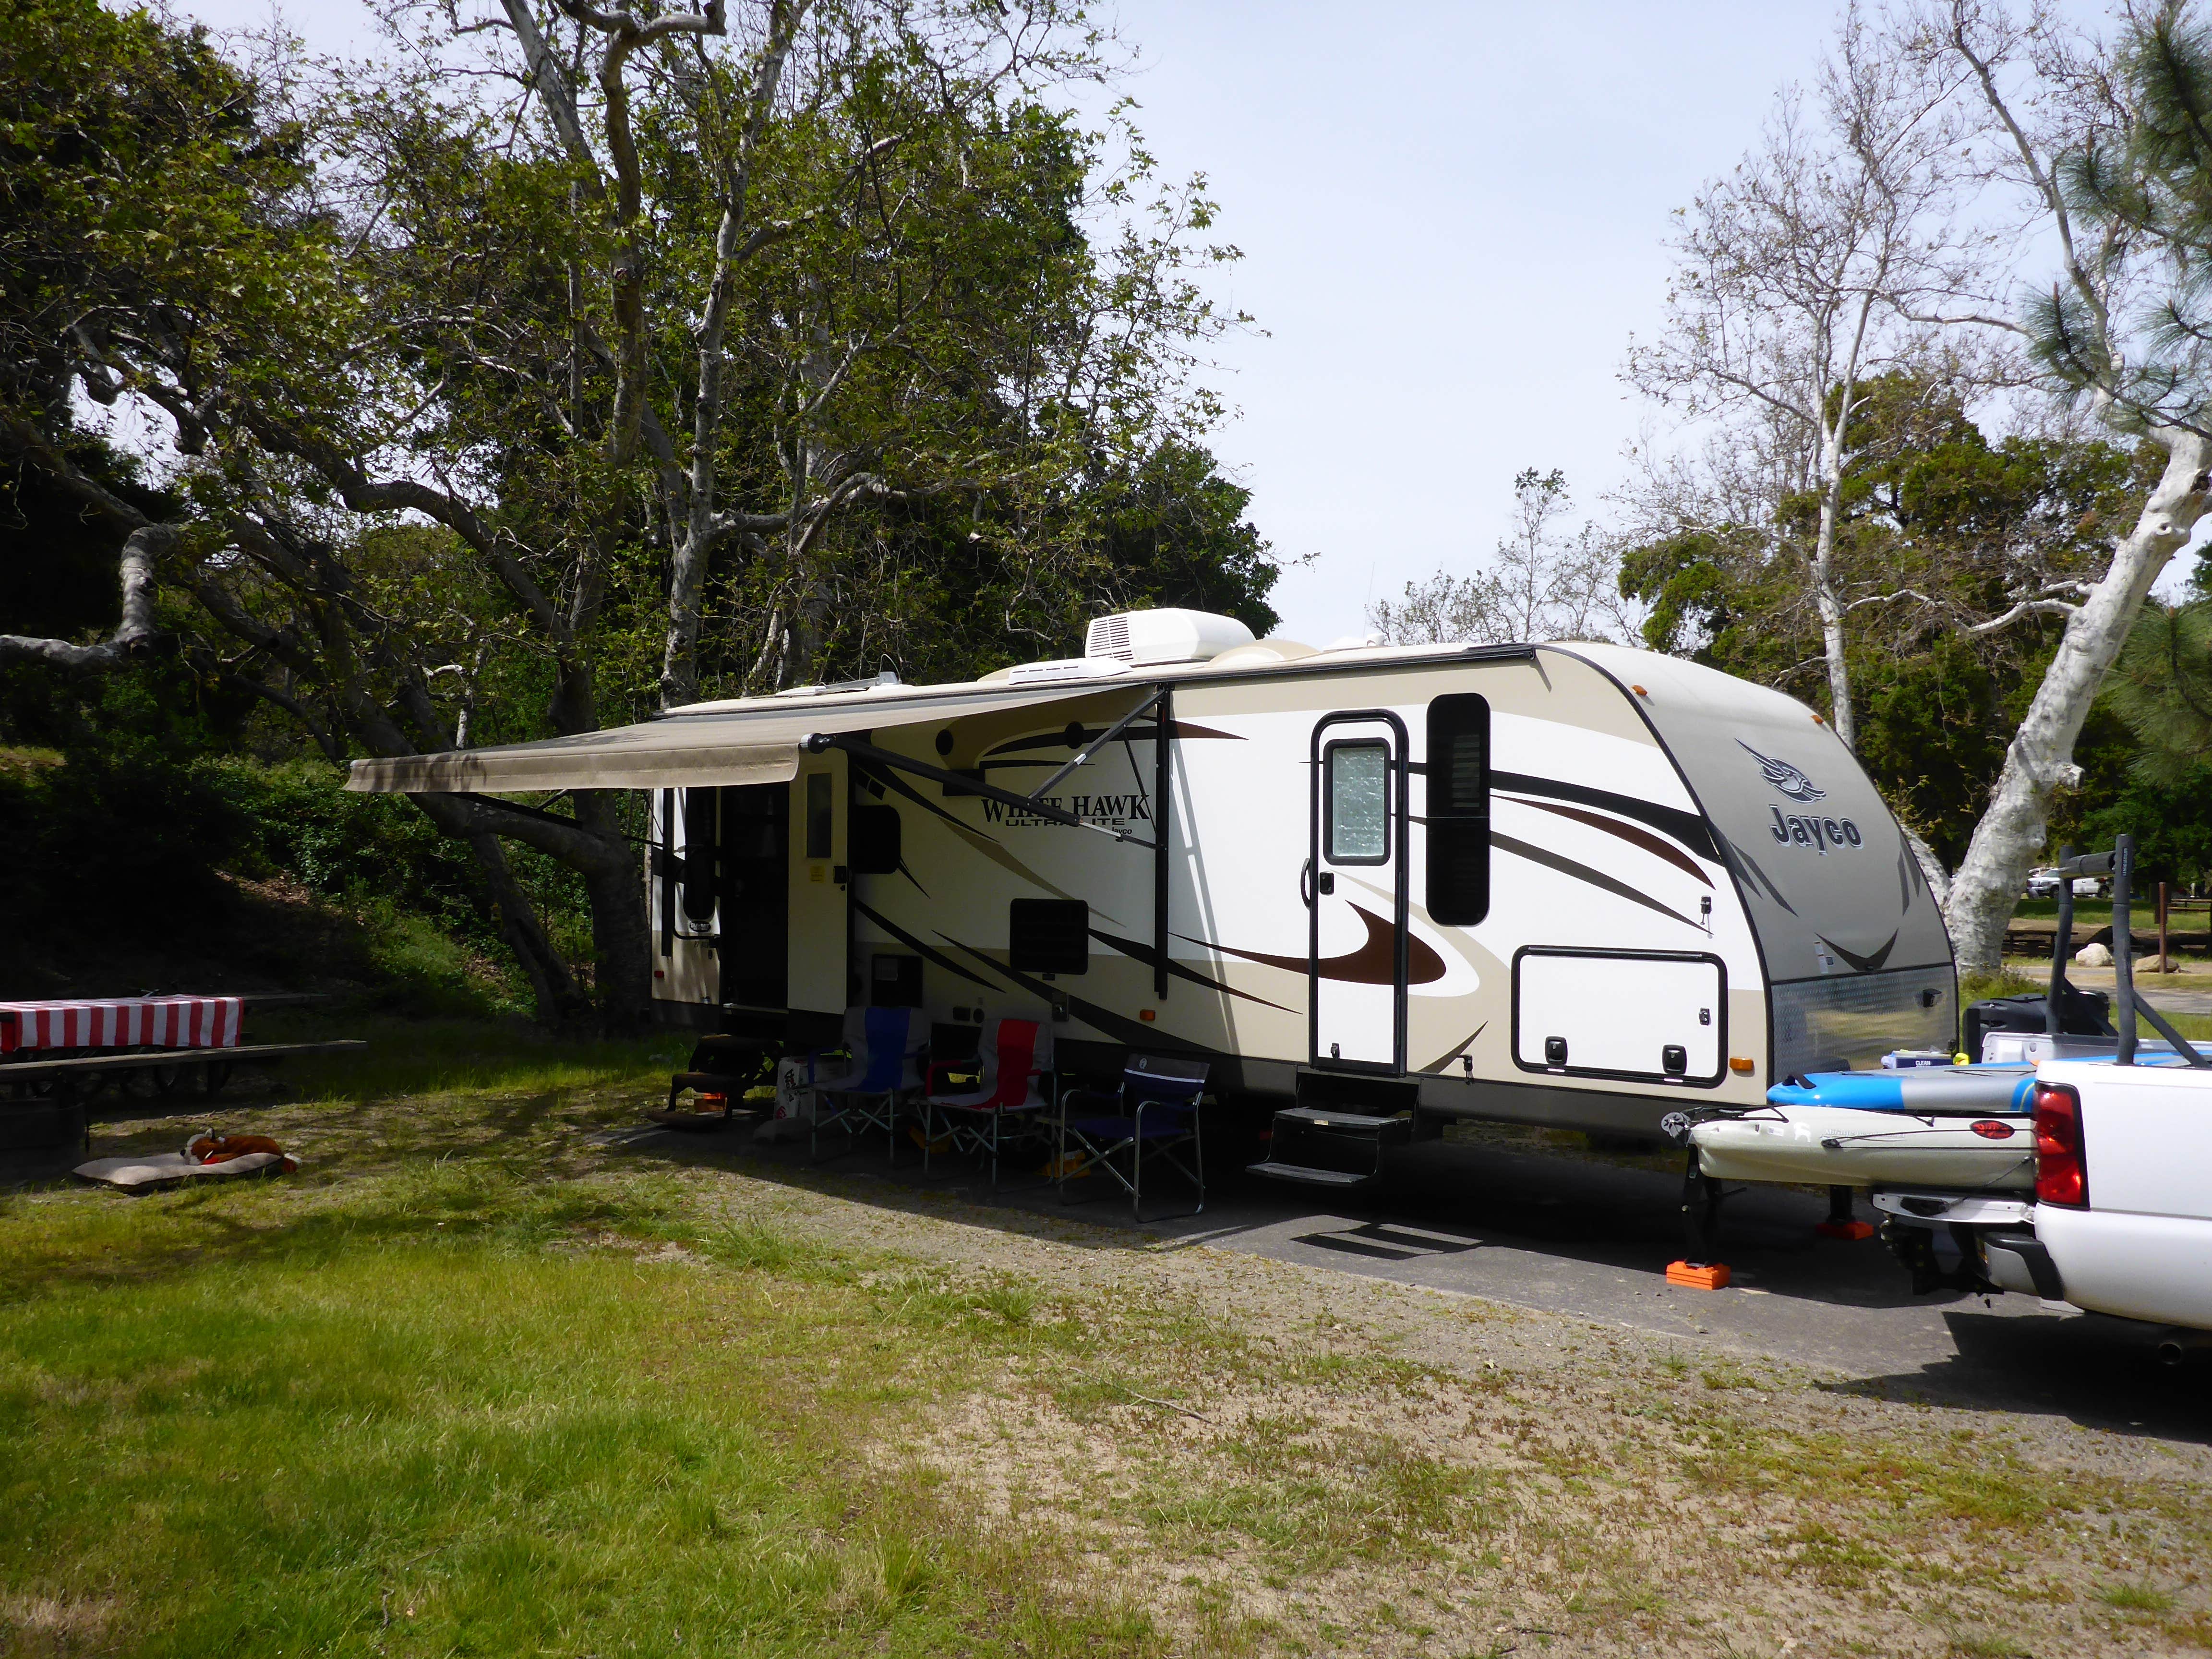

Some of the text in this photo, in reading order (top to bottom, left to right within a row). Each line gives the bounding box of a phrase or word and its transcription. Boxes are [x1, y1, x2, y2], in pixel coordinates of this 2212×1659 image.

[981, 795, 1149, 822] WHE HAWK
[1006, 818, 1067, 827] ULTR
[1768, 804, 1863, 855] Jayco
